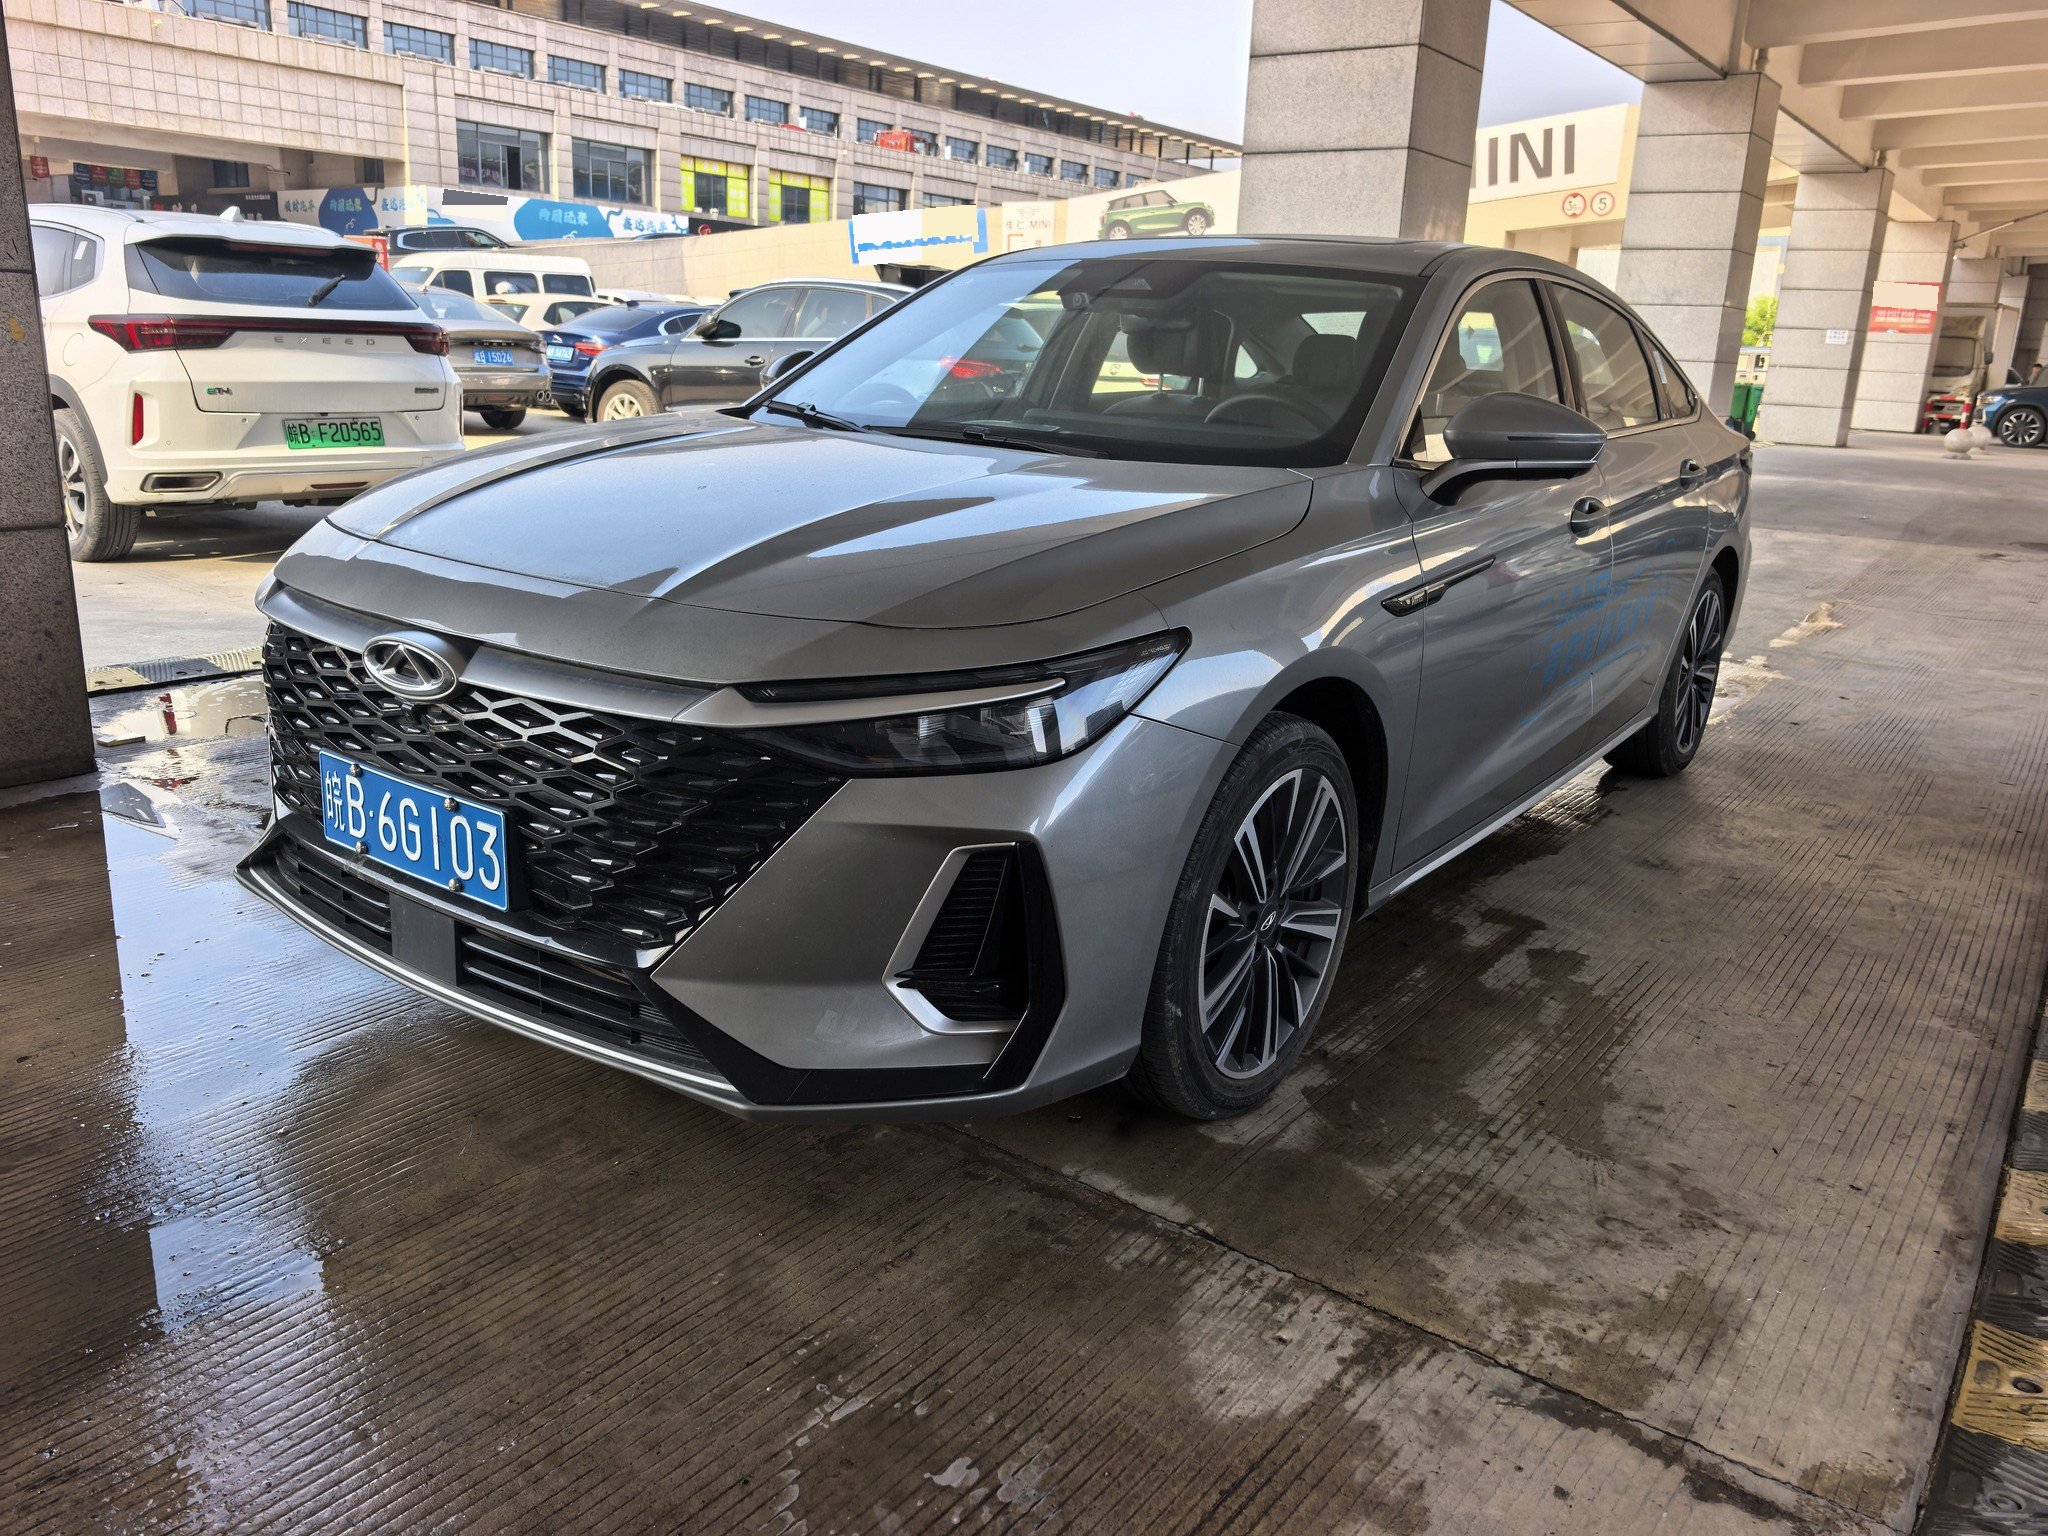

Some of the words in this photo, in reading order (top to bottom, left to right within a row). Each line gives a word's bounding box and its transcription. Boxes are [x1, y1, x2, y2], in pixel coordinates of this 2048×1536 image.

[1470, 124, 1576, 188] INI
[1598, 197, 1607, 211] 5
[274, 336, 376, 346] EXEED
